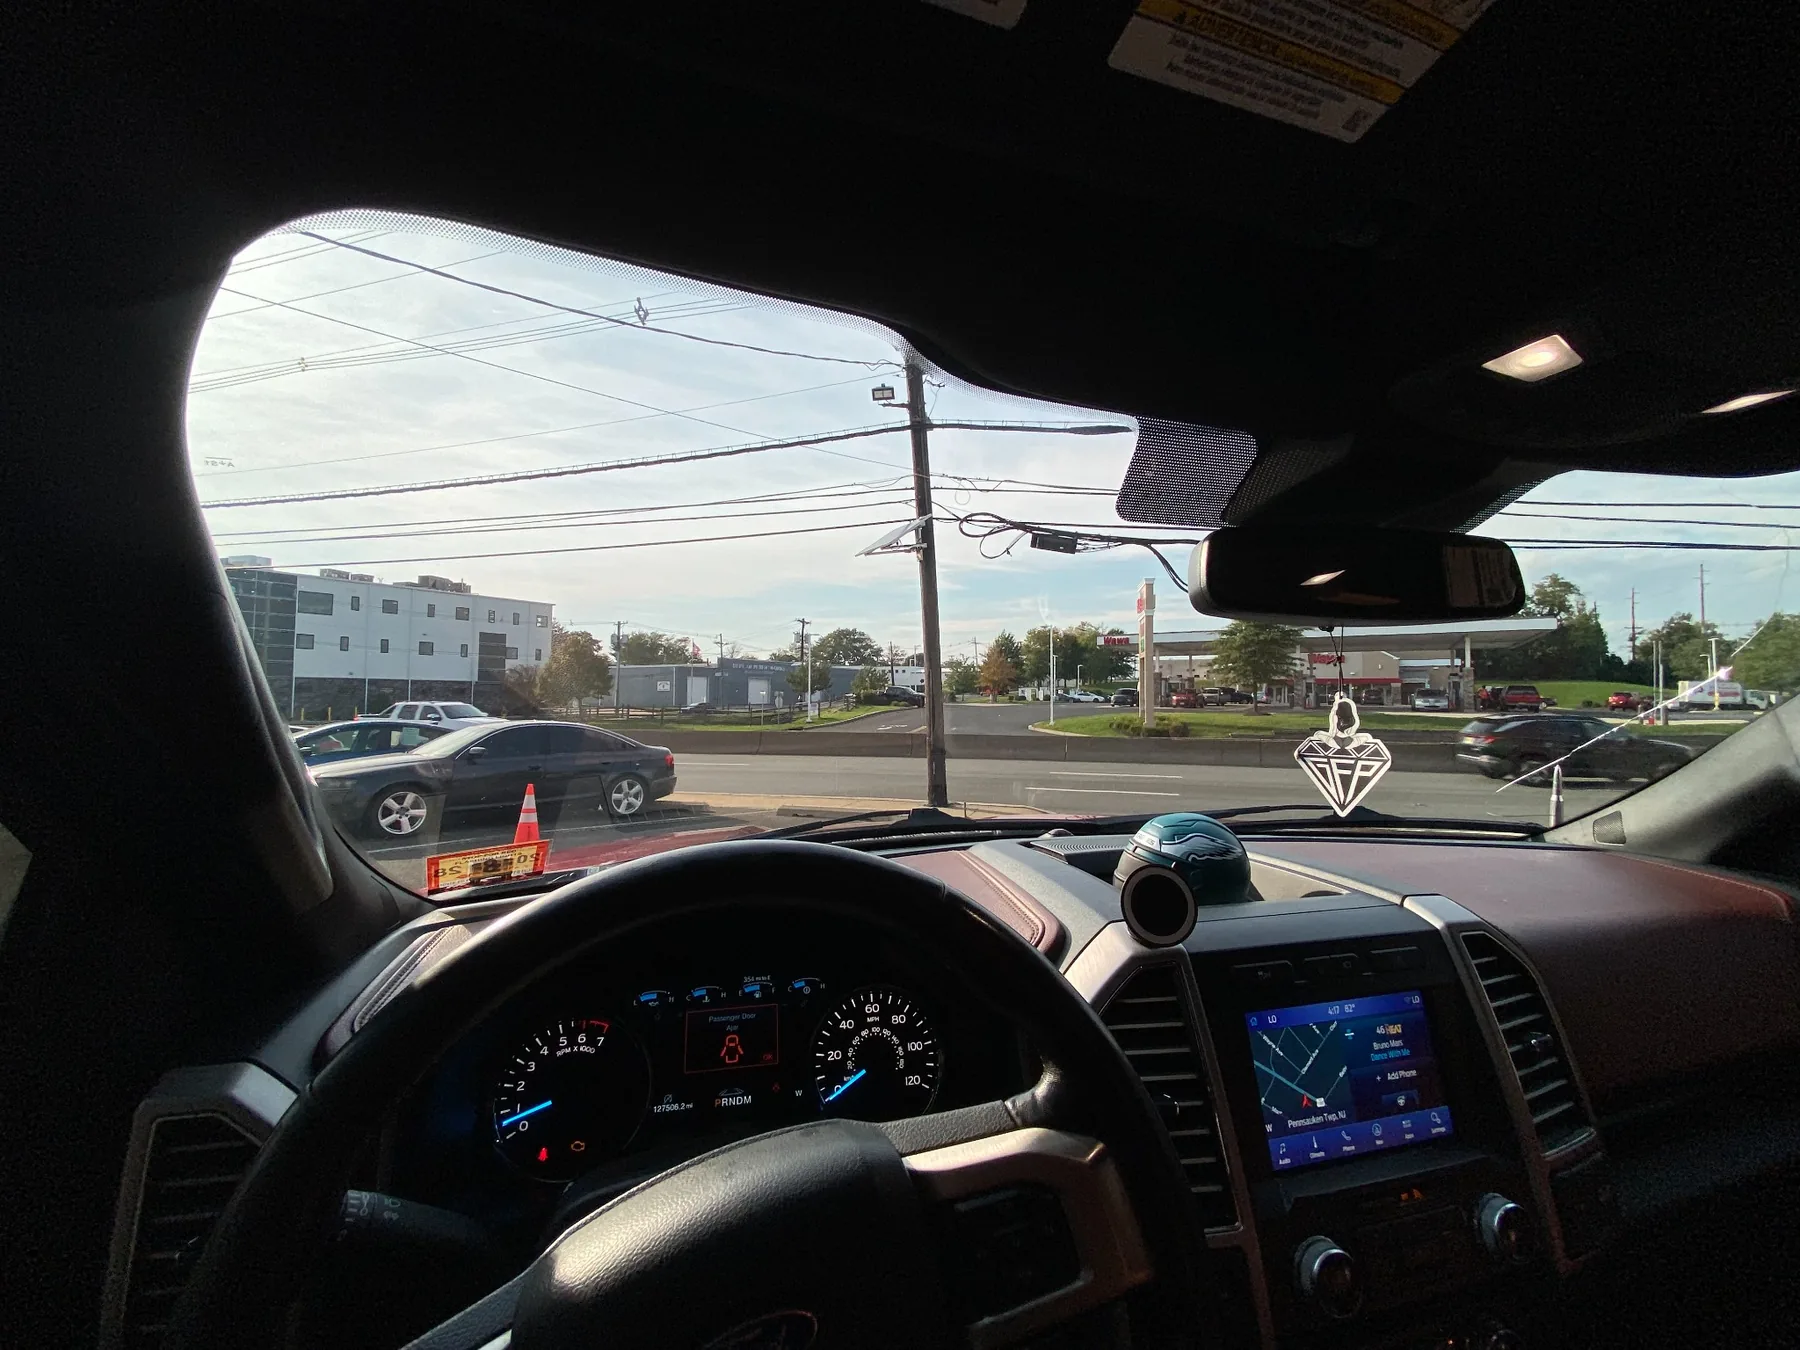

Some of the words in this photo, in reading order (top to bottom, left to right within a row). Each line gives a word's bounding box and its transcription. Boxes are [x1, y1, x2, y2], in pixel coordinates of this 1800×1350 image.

[1104, 636, 1129, 644] Wawa
[1412, 995, 1420, 1004] LO
[865, 1003, 880, 1014] 60
[1328, 1005, 1340, 1015] 4:17
[1344, 1003, 1355, 1013] 82°
[708, 1014, 740, 1023] Passenger
[891, 1014, 906, 1025] 80
[1267, 1015, 1277, 1024] LO
[839, 1019, 855, 1030] 40
[559, 1036, 568, 1047] 5
[577, 1033, 586, 1043] 6
[596, 1036, 605, 1047] 7
[907, 1041, 923, 1051] 100
[1372, 1042, 1388, 1050] Bruno
[1389, 1039, 1403, 1048] Mars
[540, 1046, 549, 1056] 4
[556, 1047, 571, 1057] RPM
[579, 1045, 596, 1054] 1000
[827, 1050, 842, 1061] 20
[1370, 1053, 1388, 1061] Dance
[1388, 1050, 1401, 1058] With
[1402, 1048, 1410, 1057] Me
[526, 1061, 536, 1072] 3
[905, 1075, 921, 1086] 120
[1387, 1071, 1399, 1081] Add
[1399, 1069, 1417, 1079] Phone
[516, 1081, 526, 1092] 2
[516, 1103, 520, 1113] 1
[1287, 1114, 1323, 1129] Pennsauken
[1338, 1110, 1347, 1119] NJ
[519, 1120, 528, 1132] 0
[1265, 1123, 1273, 1132] W
